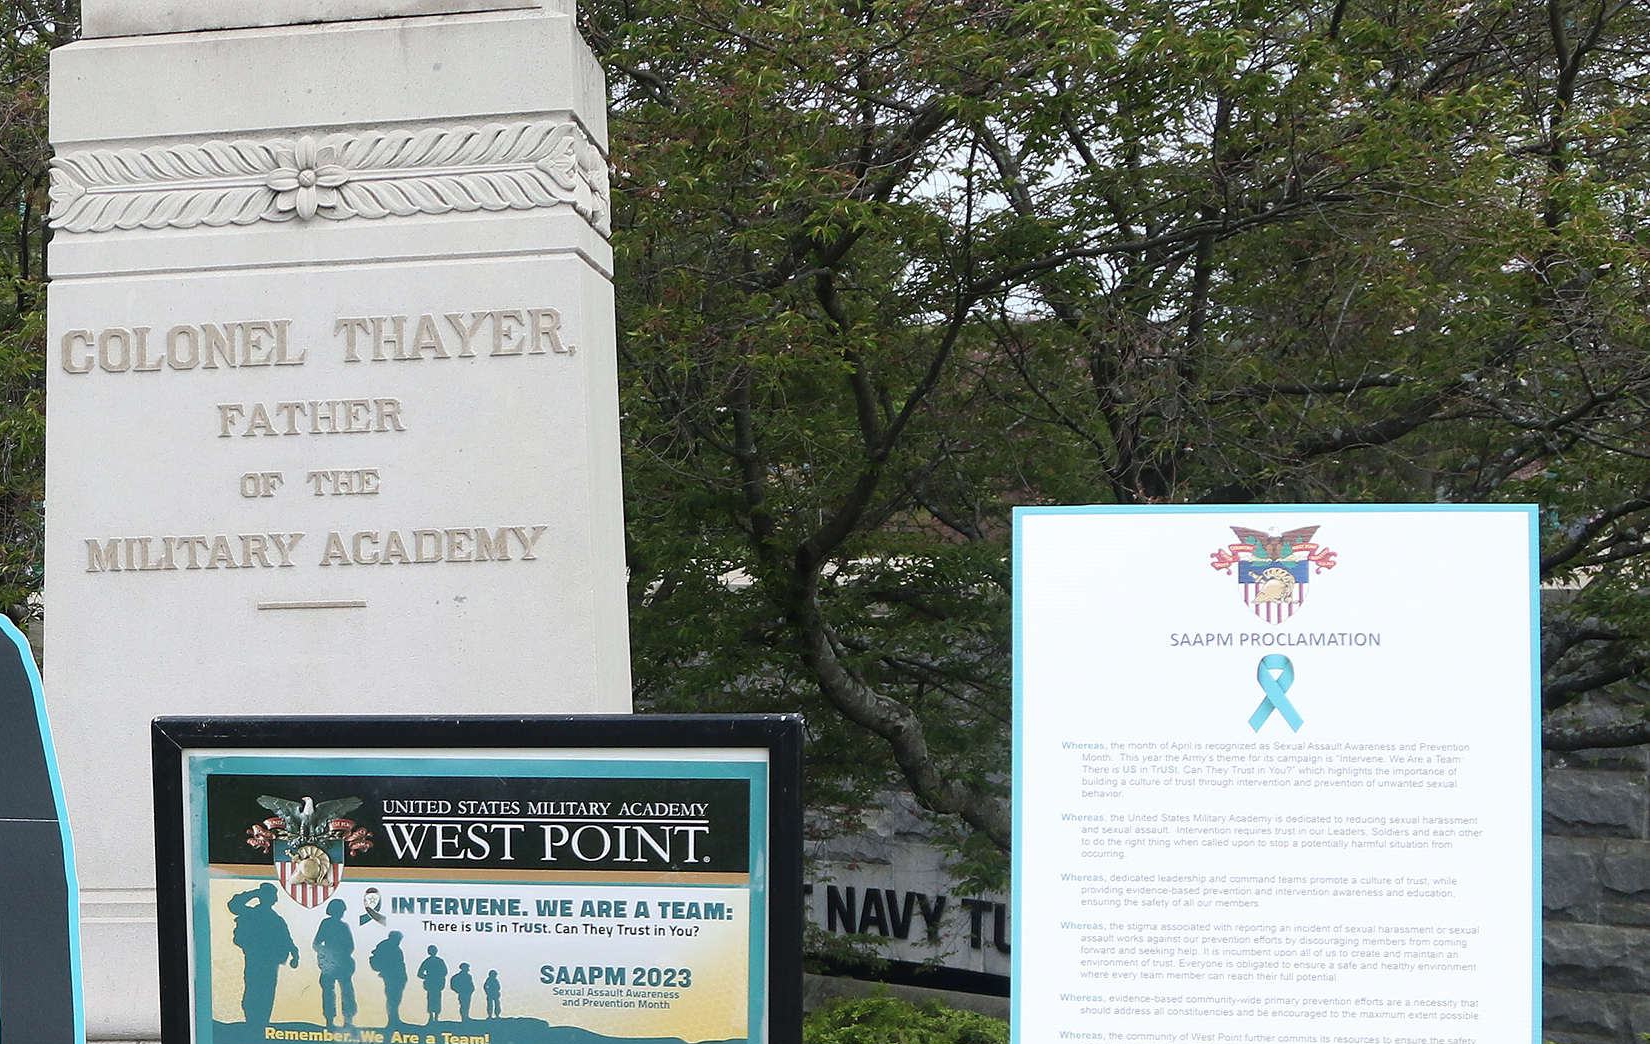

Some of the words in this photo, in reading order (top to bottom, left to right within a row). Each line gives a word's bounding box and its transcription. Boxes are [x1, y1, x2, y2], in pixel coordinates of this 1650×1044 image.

[61, 320, 309, 374] COLONEL
[333, 309, 576, 362] THAYER,
[216, 399, 406, 438] FATHER
[240, 471, 284, 498] OF
[306, 468, 380, 496] THE
[84, 533, 305, 572] MILITARY
[318, 526, 547, 566] ACADEMY
[1170, 633, 1232, 646] SAAPM
[1239, 632, 1380, 646] PROCLAMATION
[382, 800, 451, 814] UNITED
[457, 800, 520, 814] STATES
[527, 801, 611, 815] MILITARY
[617, 802, 708, 816] ACADEMY
[382, 823, 524, 860] WEST
[391, 897, 528, 916] INTERVENE.
[535, 899, 573, 917] WE
[579, 900, 627, 918] ARE
[633, 900, 650, 918] A
[657, 901, 732, 920] TEAM:
[826, 884, 946, 940] NAVY
[422, 920, 457, 931] There
[461, 921, 471, 932] is
[475, 921, 492, 932] US
[496, 921, 507, 932] in
[511, 922, 551, 933] TrUSt.
[555, 922, 578, 934] Can
[582, 923, 613, 937] They
[616, 924, 650, 935] Trust
[654, 924, 665, 935] in
[669, 925, 699, 936] You?
[539, 965, 625, 985] SAAPM
[628, 967, 691, 987] 2023
[553, 987, 584, 996] Sexual
[587, 988, 624, 997] Assault
[626, 989, 680, 999] Awareness
[562, 999, 580, 1007] and
[582, 999, 636, 1008] Prevention
[638, 1000, 670, 1009] Month
[390, 1031, 419, 1043] Are
[425, 1035, 435, 1044] a
